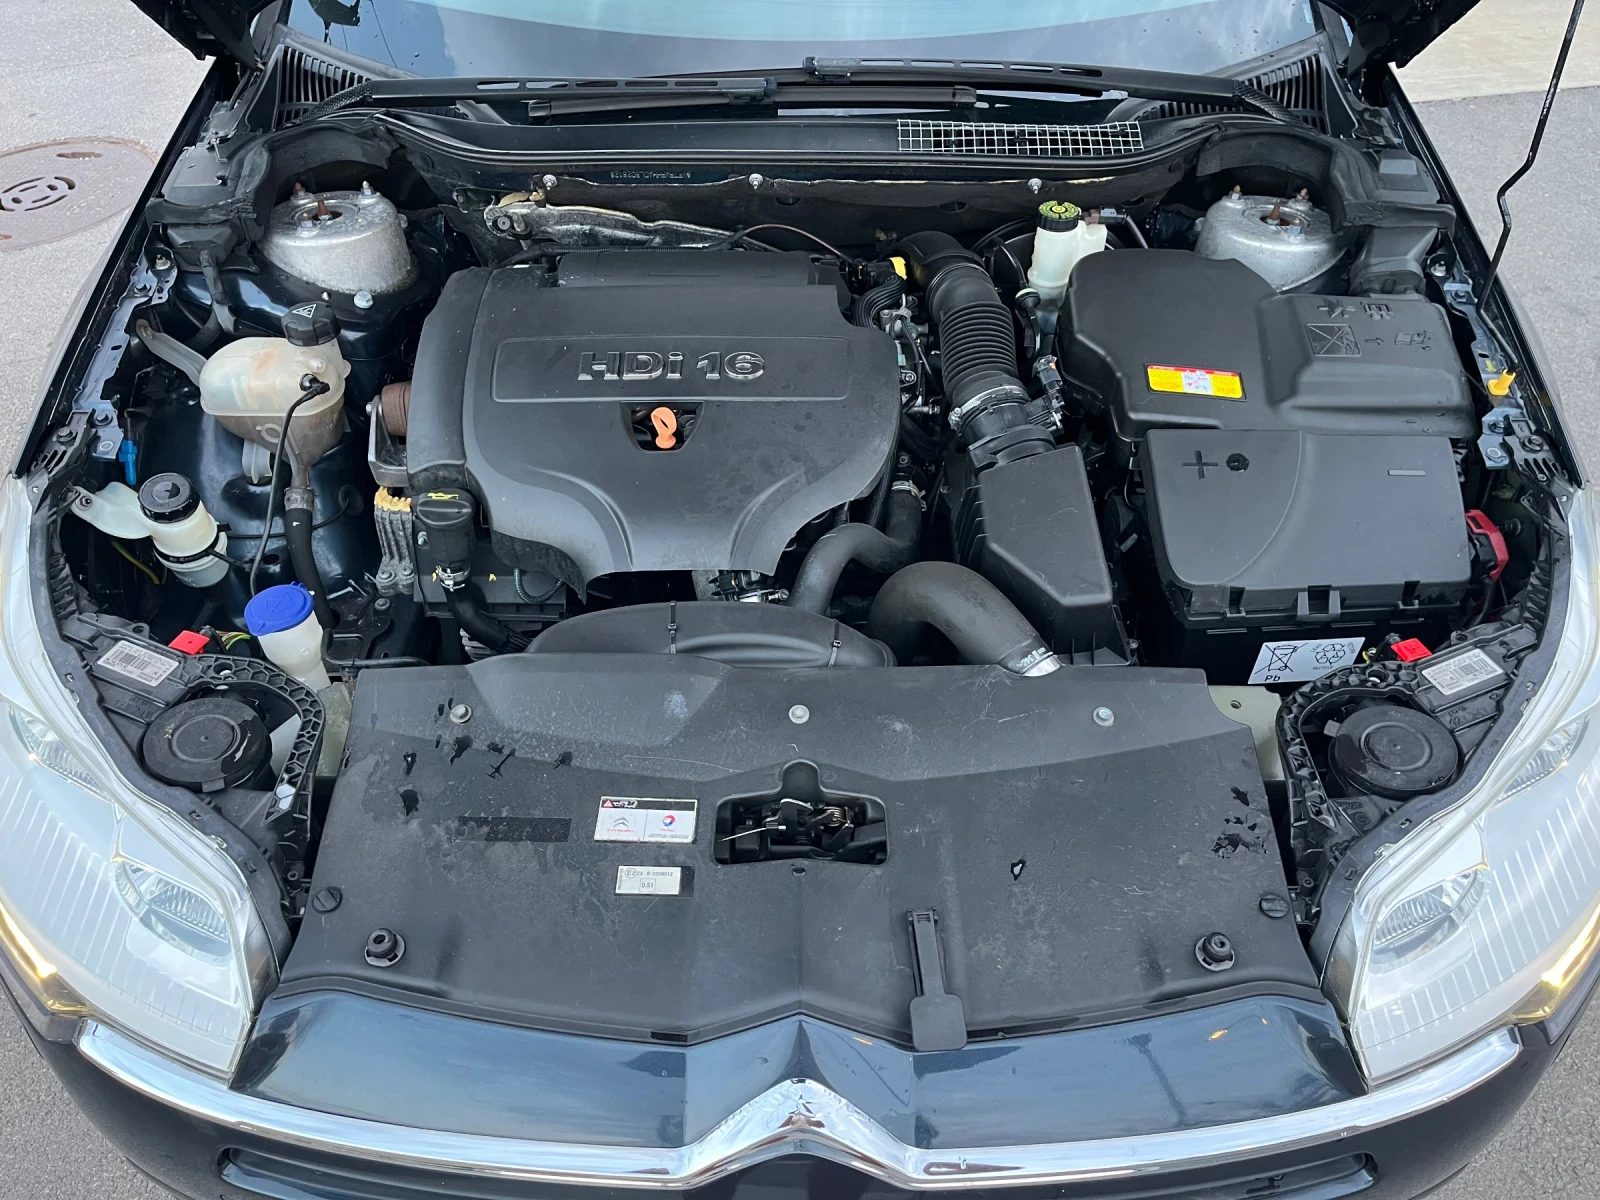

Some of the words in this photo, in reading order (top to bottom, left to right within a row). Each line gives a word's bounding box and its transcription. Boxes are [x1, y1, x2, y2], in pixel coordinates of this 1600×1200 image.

[578, 351, 684, 381] HDi
[696, 351, 765, 380] 16
[1264, 674, 1281, 682] Pb
